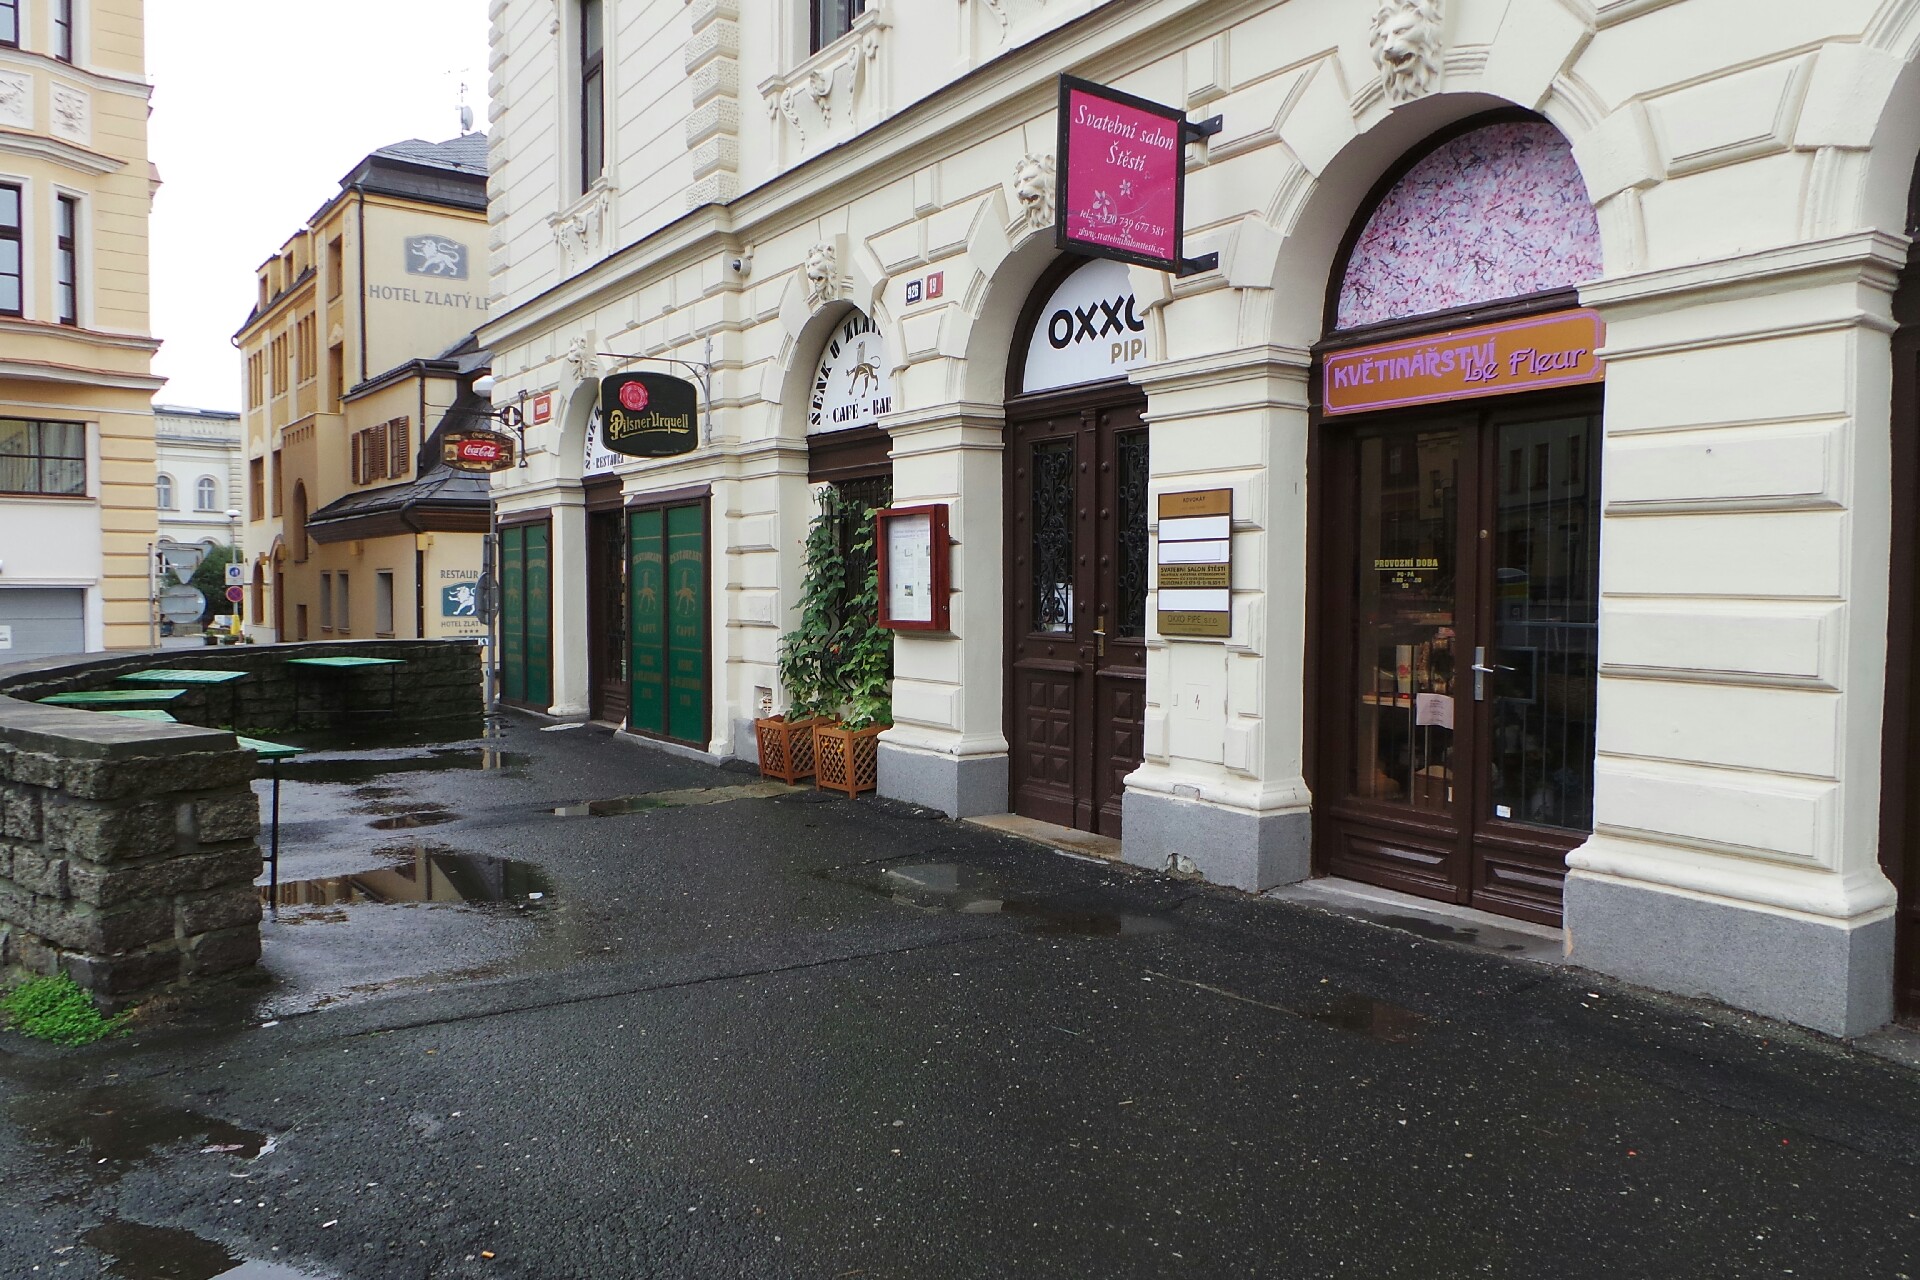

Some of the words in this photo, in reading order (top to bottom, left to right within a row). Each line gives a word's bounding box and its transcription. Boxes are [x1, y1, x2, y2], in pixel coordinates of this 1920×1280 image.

[1075, 105, 1137, 139] Svatební
[1140, 128, 1174, 150] salon
[1106, 140, 1147, 171] Štěstí
[1119, 217, 1134, 228] 739
[369, 284, 421, 304] HOTEL
[425, 291, 472, 309] ZLATÝ
[907, 284, 919, 299] 926
[929, 278, 937, 293] 19
[1111, 337, 1146, 365] PIP
[1334, 337, 1497, 389] KVĚTINÁŘSTVÍ
[1464, 358, 1500, 383] Le
[1509, 347, 1587, 377] Fleur
[833, 399, 858, 423] CAFÉ
[609, 409, 651, 440] Pilsner
[650, 411, 689, 434] Urquell
[1374, 558, 1414, 567] PROVOZNÍ
[1416, 559, 1438, 567] DOBA
